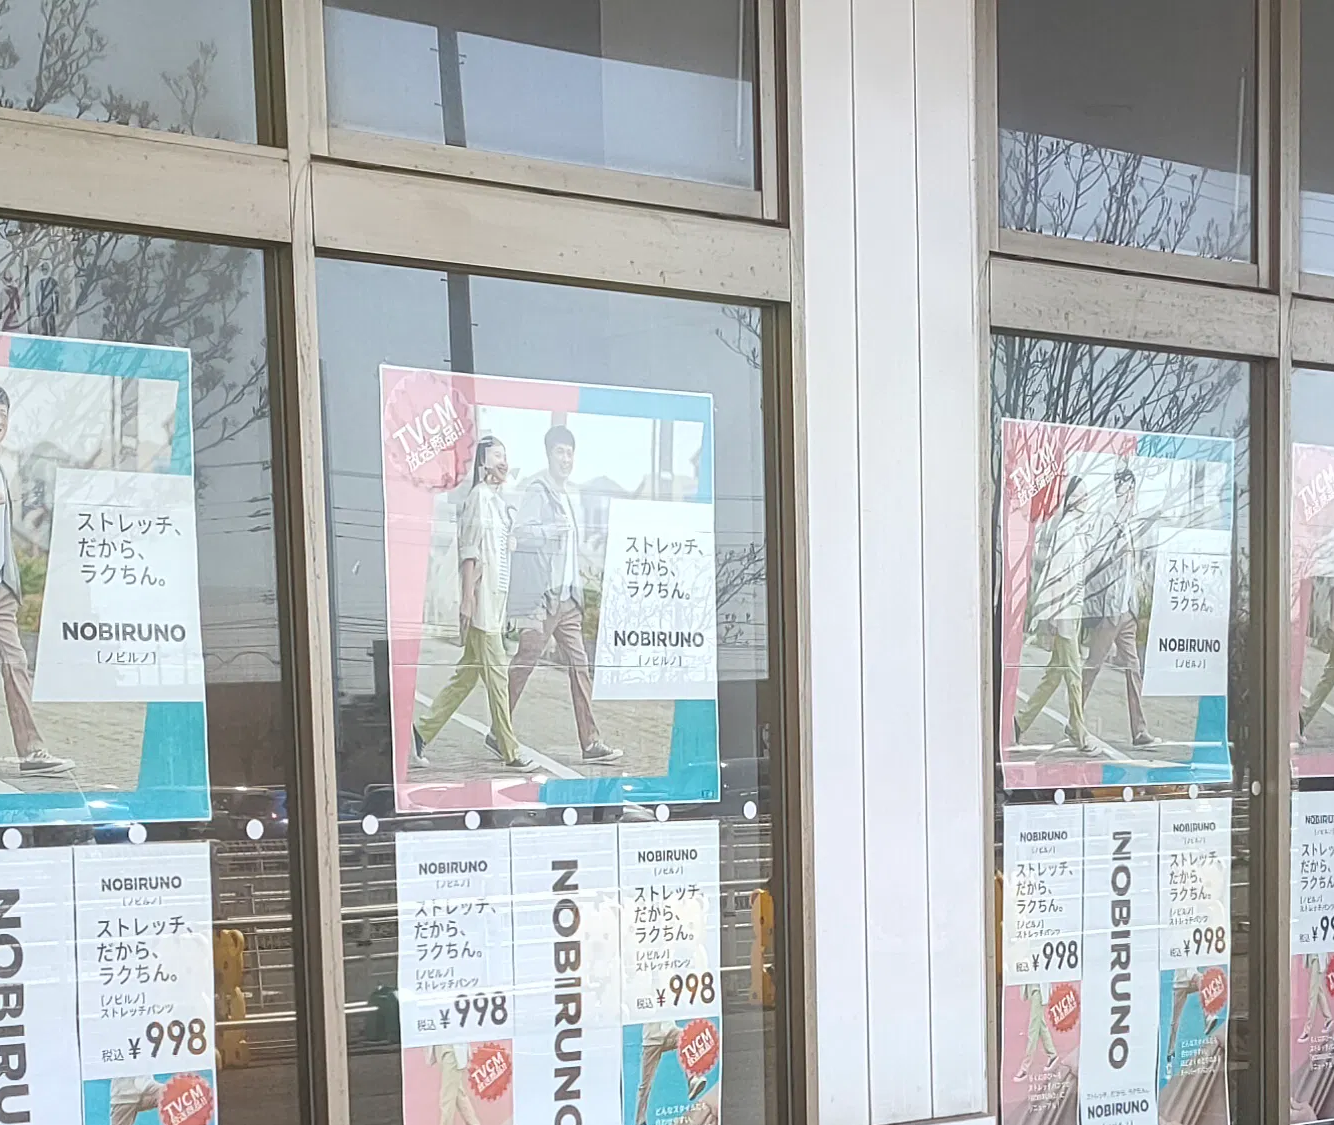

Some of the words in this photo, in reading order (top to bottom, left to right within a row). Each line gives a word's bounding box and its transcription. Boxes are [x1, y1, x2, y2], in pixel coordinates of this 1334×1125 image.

[392, 394, 457, 454] TVCM
[1010, 444, 1055, 494] TVCM
[78, 513, 181, 535] ストレッチ、
[78, 538, 144, 560] だから、
[626, 536, 703, 556] ストレッチ、
[81, 564, 165, 586] ラクちん。
[626, 558, 675, 577] だから、
[1168, 558, 1222, 576] ストレッチ、
[627, 580, 690, 600] ラクちん。
[1168, 577, 1204, 594] だから、
[1170, 596, 1215, 612] ラクちん。
[62, 622, 185, 642] NOBIRUNO
[614, 630, 704, 648] NOBIRUNO
[1159, 637, 1220, 653] NOBIRUNO
[97, 651, 156, 664] [ノビルノ]
[1020, 830, 1067, 842] NOBIRUNO
[638, 849, 697, 863] NOBIRUNO
[1170, 851, 1221, 867] ストレッチ、
[418, 860, 488, 875] NOBIRUNO
[1016, 861, 1073, 878] ストレッチ、
[1300, 859, 1331, 874] だから、
[101, 876, 182, 892] NOBIRUNO
[634, 884, 704, 902] ストレッチ、
[1016, 880, 1053, 896] だから、
[1170, 886, 1211, 902] ラクちん。
[634, 906, 680, 923] だから、
[1017, 899, 1063, 914] ラクちん。
[97, 916, 193, 937] ストレッチ、
[414, 920, 466, 940] だから、
[635, 925, 694, 944] ラクちん。
[97, 941, 158, 963] だから、
[417, 941, 482, 962] ラクちん。
[1108, 830, 1131, 1069] NOBIRUNO
[99, 964, 177, 986] ラクちん。
[101, 993, 145, 1007] [ノビルノ]
[1050, 991, 1075, 1020] TVCM
[101, 1004, 174, 1019] ストレッチパンツ
[682, 1028, 712, 1059] TVCM
[102, 1049, 124, 1062] 税込
[471, 1052, 505, 1085] TVCM
[163, 1084, 203, 1119] TVCM
[1087, 1099, 1149, 1119] NOBIRUNO
